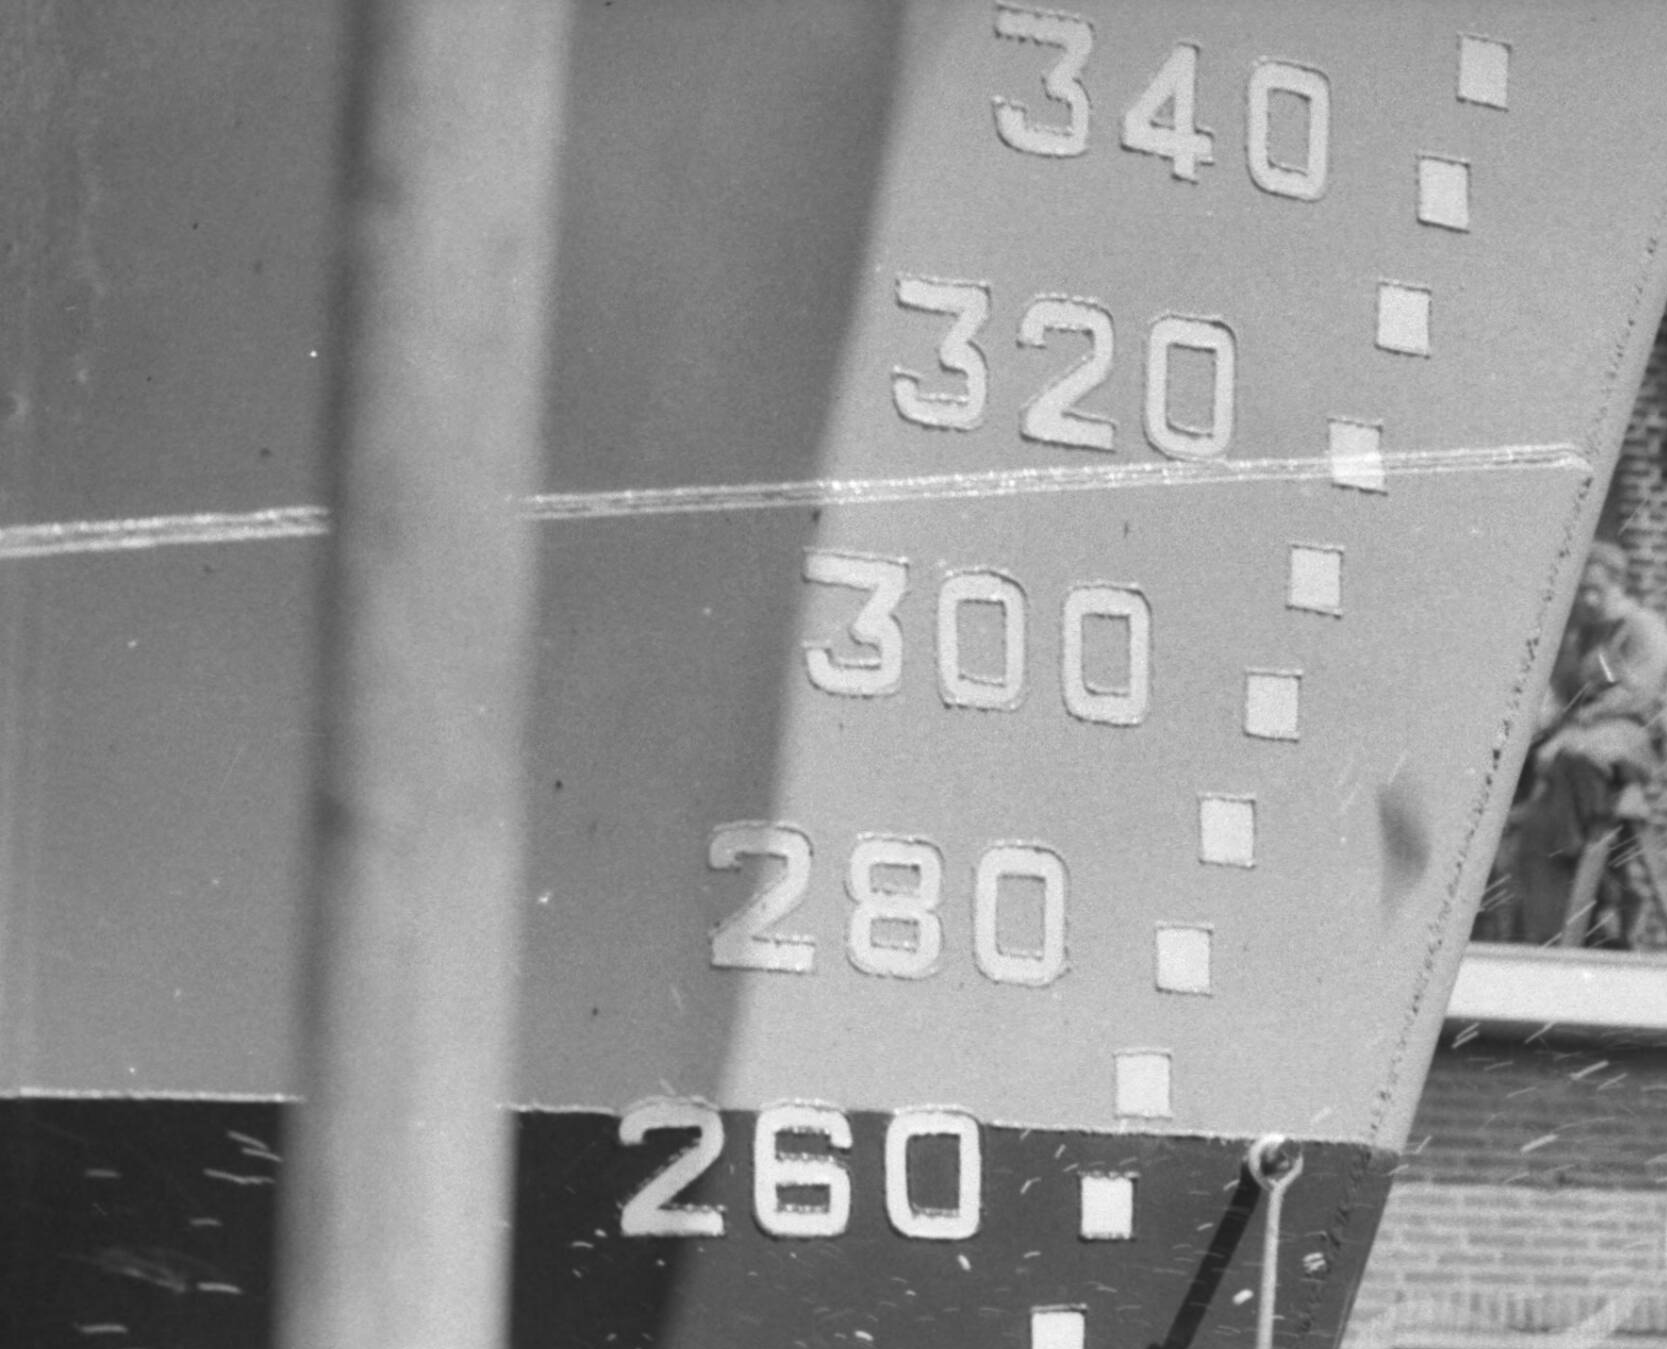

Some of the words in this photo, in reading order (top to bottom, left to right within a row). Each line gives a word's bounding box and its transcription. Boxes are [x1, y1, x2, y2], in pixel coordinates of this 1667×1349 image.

[991, 12, 1330, 200] 340
[892, 274, 1236, 459] 320
[802, 547, 1152, 726] 300
[706, 822, 1070, 985] 280
[617, 1102, 982, 1239] 260
